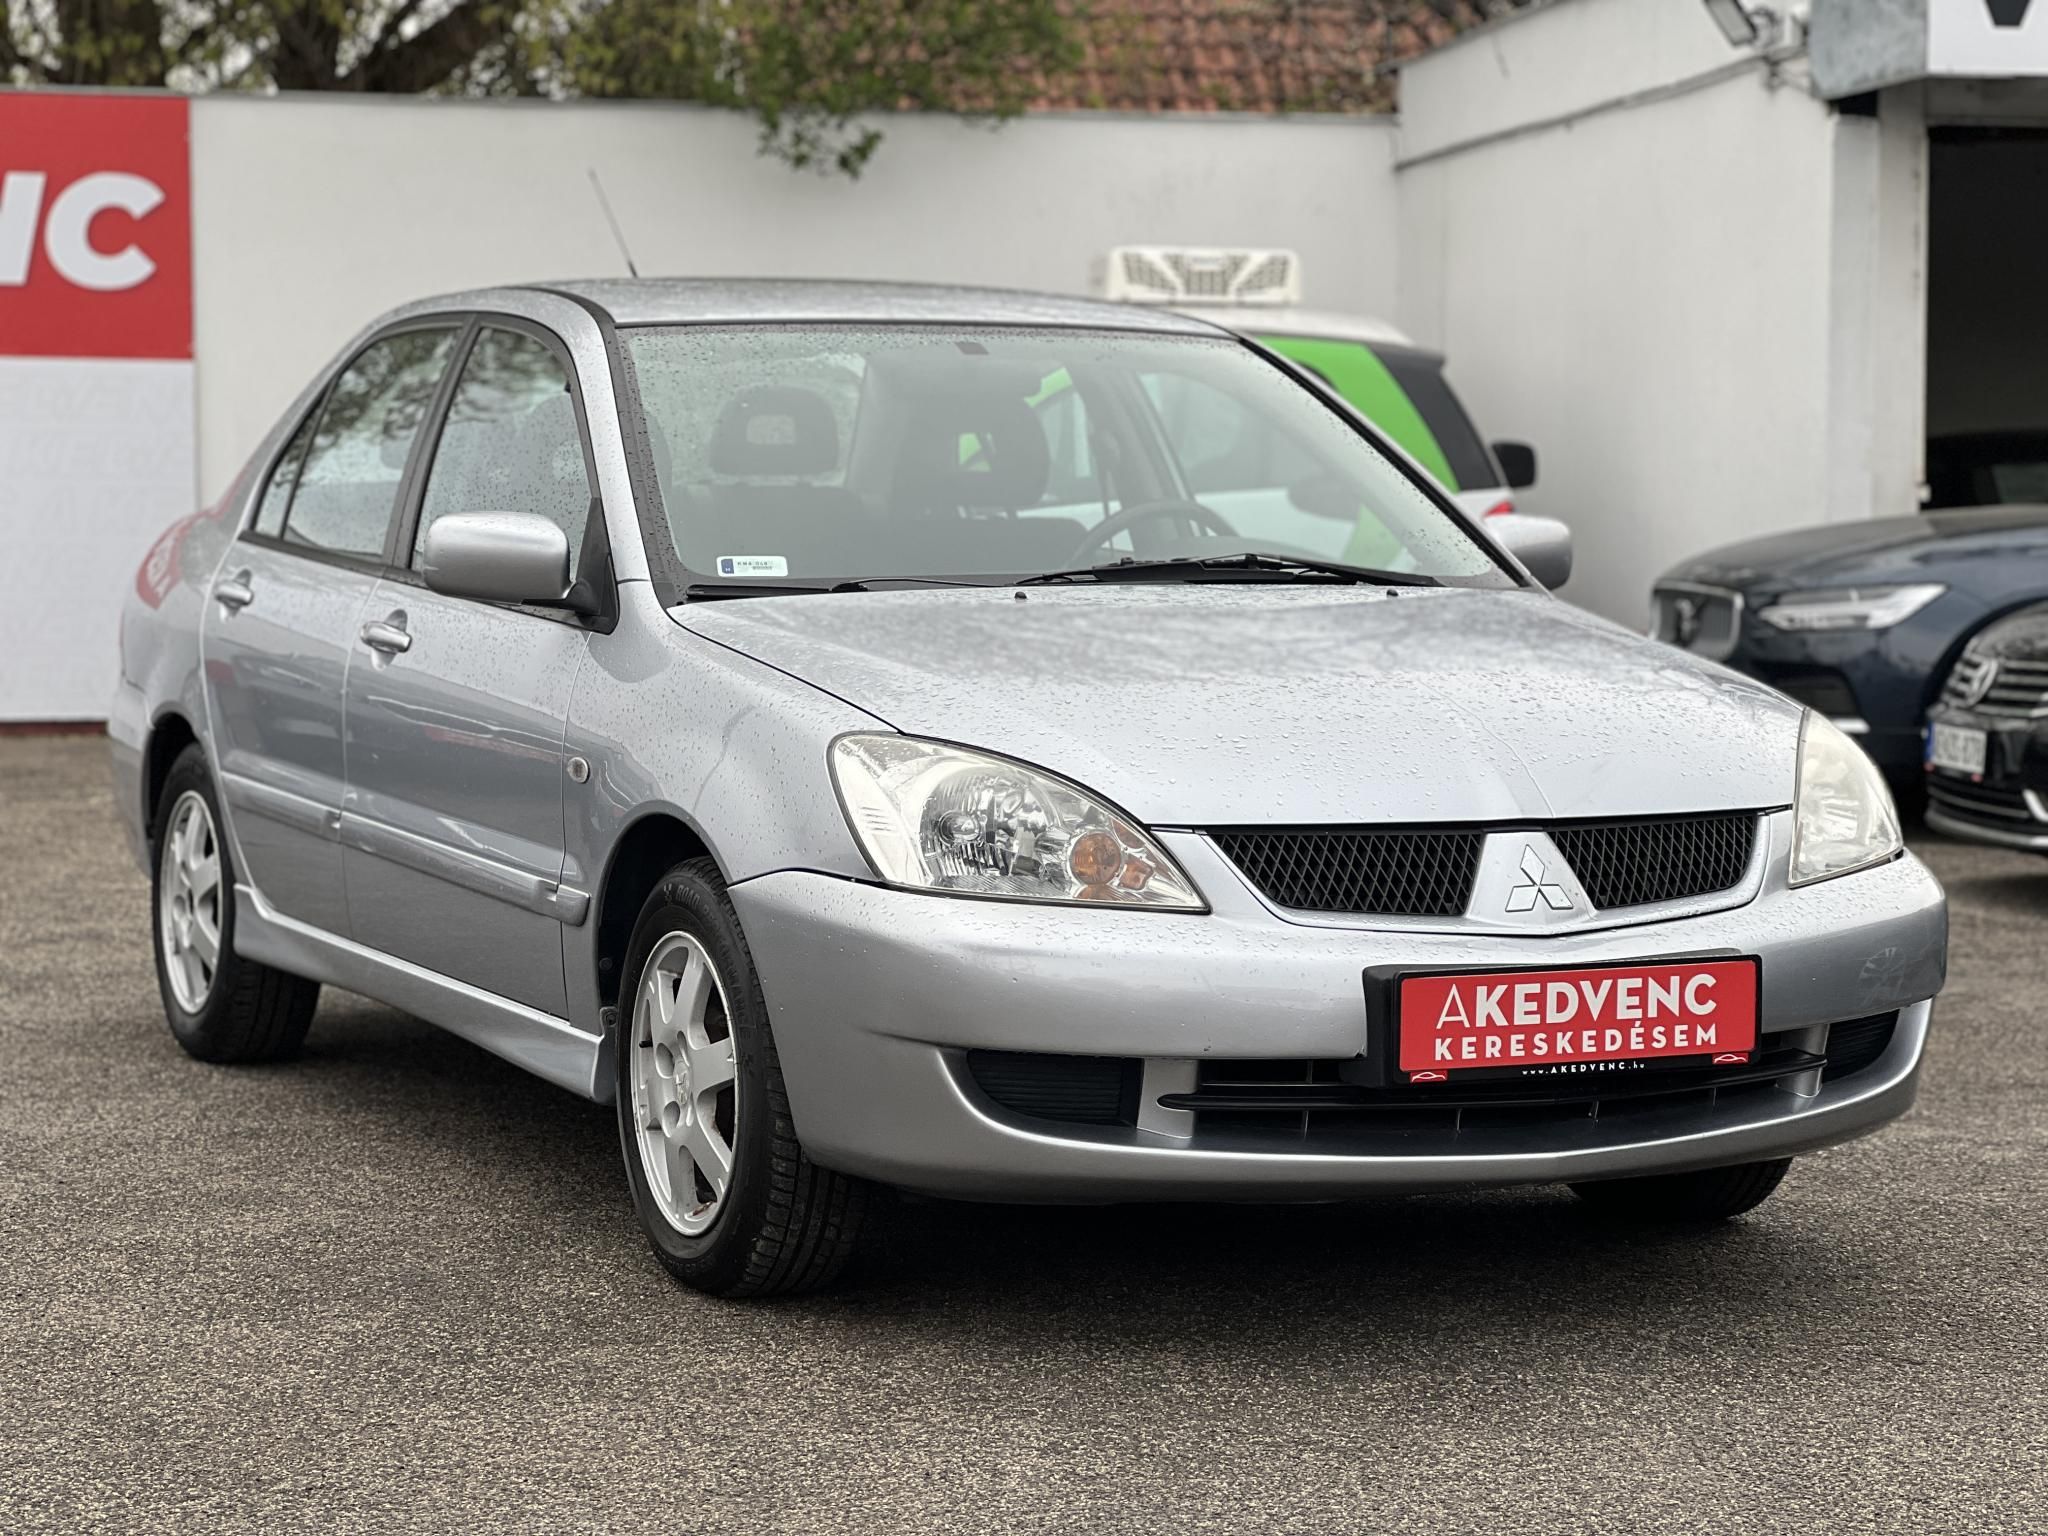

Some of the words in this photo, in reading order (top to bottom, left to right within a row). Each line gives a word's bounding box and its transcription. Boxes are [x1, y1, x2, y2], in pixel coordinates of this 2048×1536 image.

[1436, 974, 1717, 1029] AKEDVENC
[1435, 1021, 1717, 1061] KERESKEDÉSEM
[1522, 1061, 1645, 1075] www.AKEDVENC.hu
